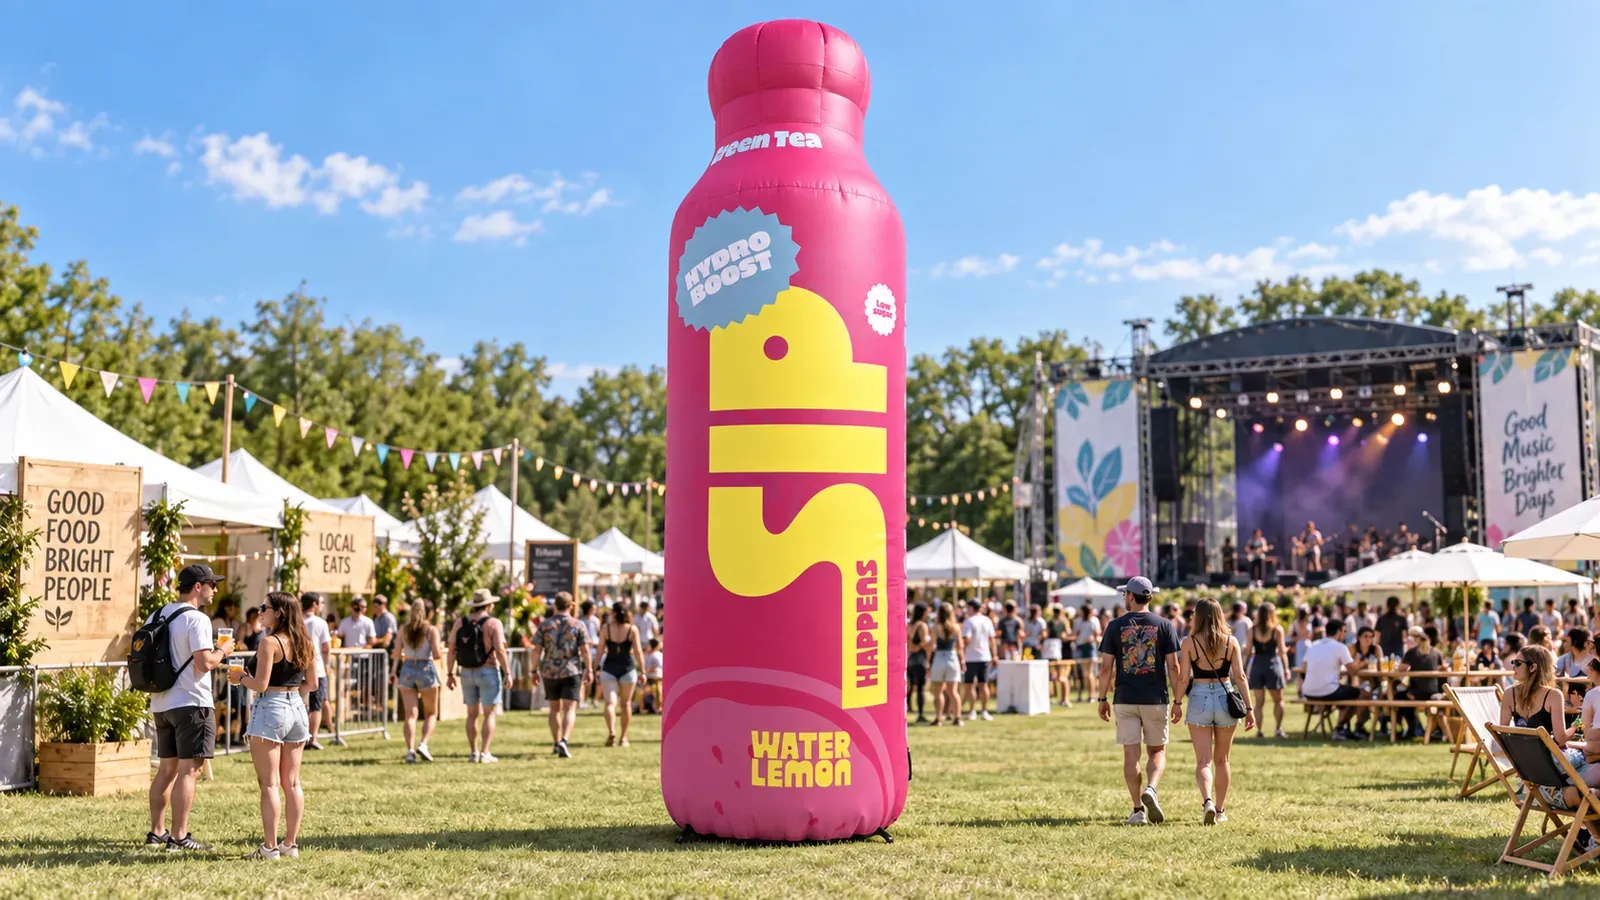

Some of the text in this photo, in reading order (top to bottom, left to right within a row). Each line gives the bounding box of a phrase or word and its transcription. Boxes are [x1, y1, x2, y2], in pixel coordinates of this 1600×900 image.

[710, 130, 823, 166] reen Tea
[684, 230, 771, 291] HYDRO
[689, 249, 772, 307] BOOST
[1504, 402, 1548, 438] Good
[1502, 433, 1555, 465] Music
[1502, 461, 1566, 494] Brighter
[47, 488, 105, 516] GOOD
[708, 286, 887, 709] SIP
[1515, 489, 1555, 519] Days
[46, 518, 100, 545] FOOD
[319, 532, 356, 553] LOCAL
[45, 547, 115, 574] BRIGHT
[322, 554, 351, 574] EATS
[44, 576, 112, 602] PEOPLE
[855, 559, 878, 688] HAPPENS
[750, 729, 851, 759] WATER
[750, 757, 851, 788] LEMON
